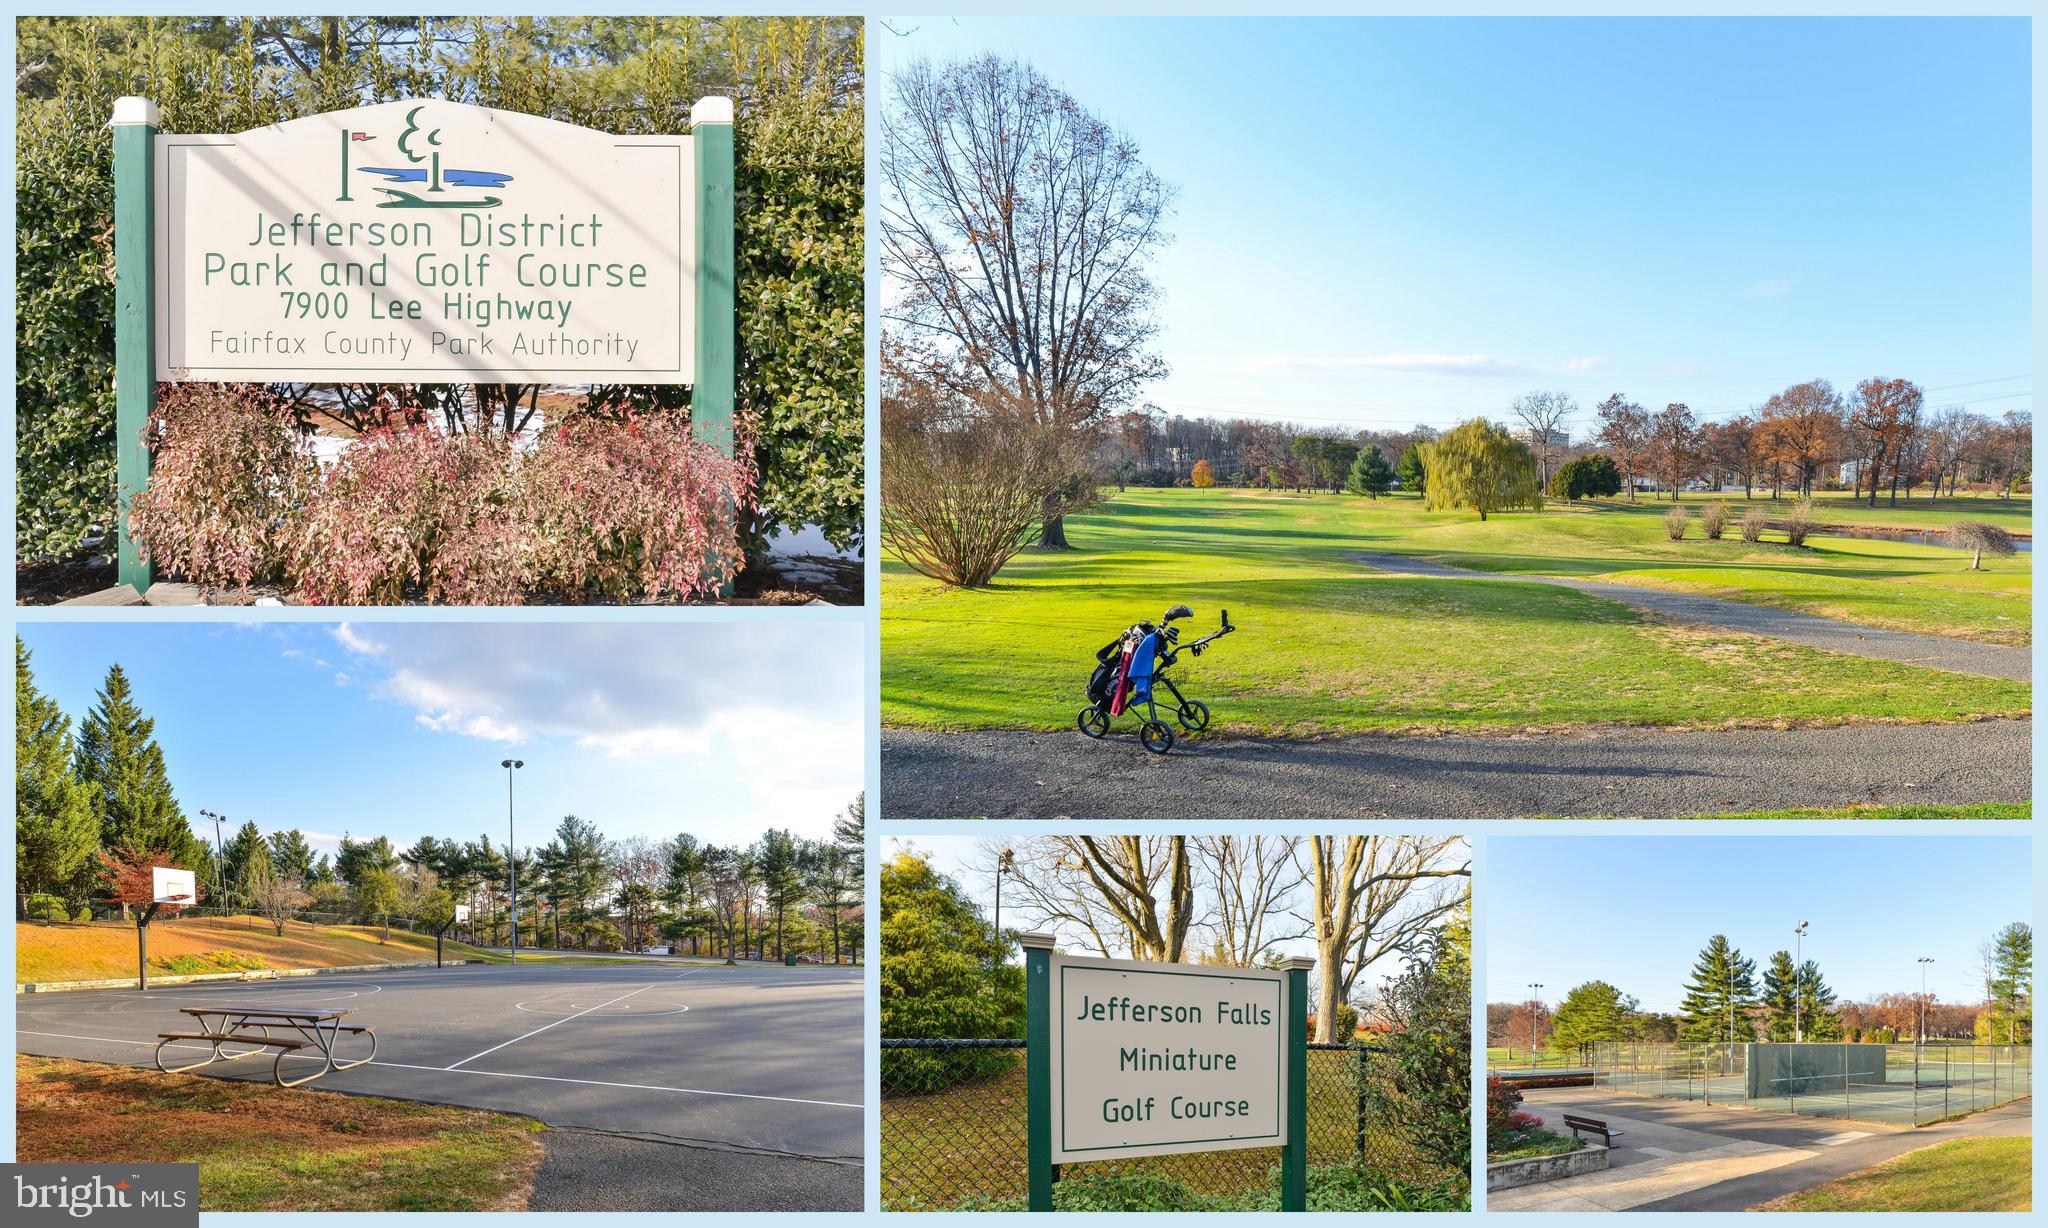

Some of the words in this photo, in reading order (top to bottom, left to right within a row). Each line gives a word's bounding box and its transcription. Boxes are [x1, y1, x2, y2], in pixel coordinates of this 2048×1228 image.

[248, 212, 432, 249] Jefferson
[460, 211, 603, 249] District
[204, 252, 294, 288] Park
[320, 253, 388, 289] and
[415, 251, 491, 289] Golf
[516, 252, 648, 289] Course
[280, 291, 349, 321] 7900
[370, 294, 422, 321] Lee
[443, 292, 573, 329] Highway
[210, 331, 306, 356] Fairfax
[324, 331, 412, 362] County
[431, 331, 494, 356] Park
[511, 331, 640, 363] Authority
[1077, 995, 1202, 1024] Jefferson
[1217, 1001, 1272, 1025] Falls
[1119, 1047, 1237, 1072] Miniature
[1102, 1097, 1155, 1123] Golf
[1170, 1096, 1250, 1120] Course
